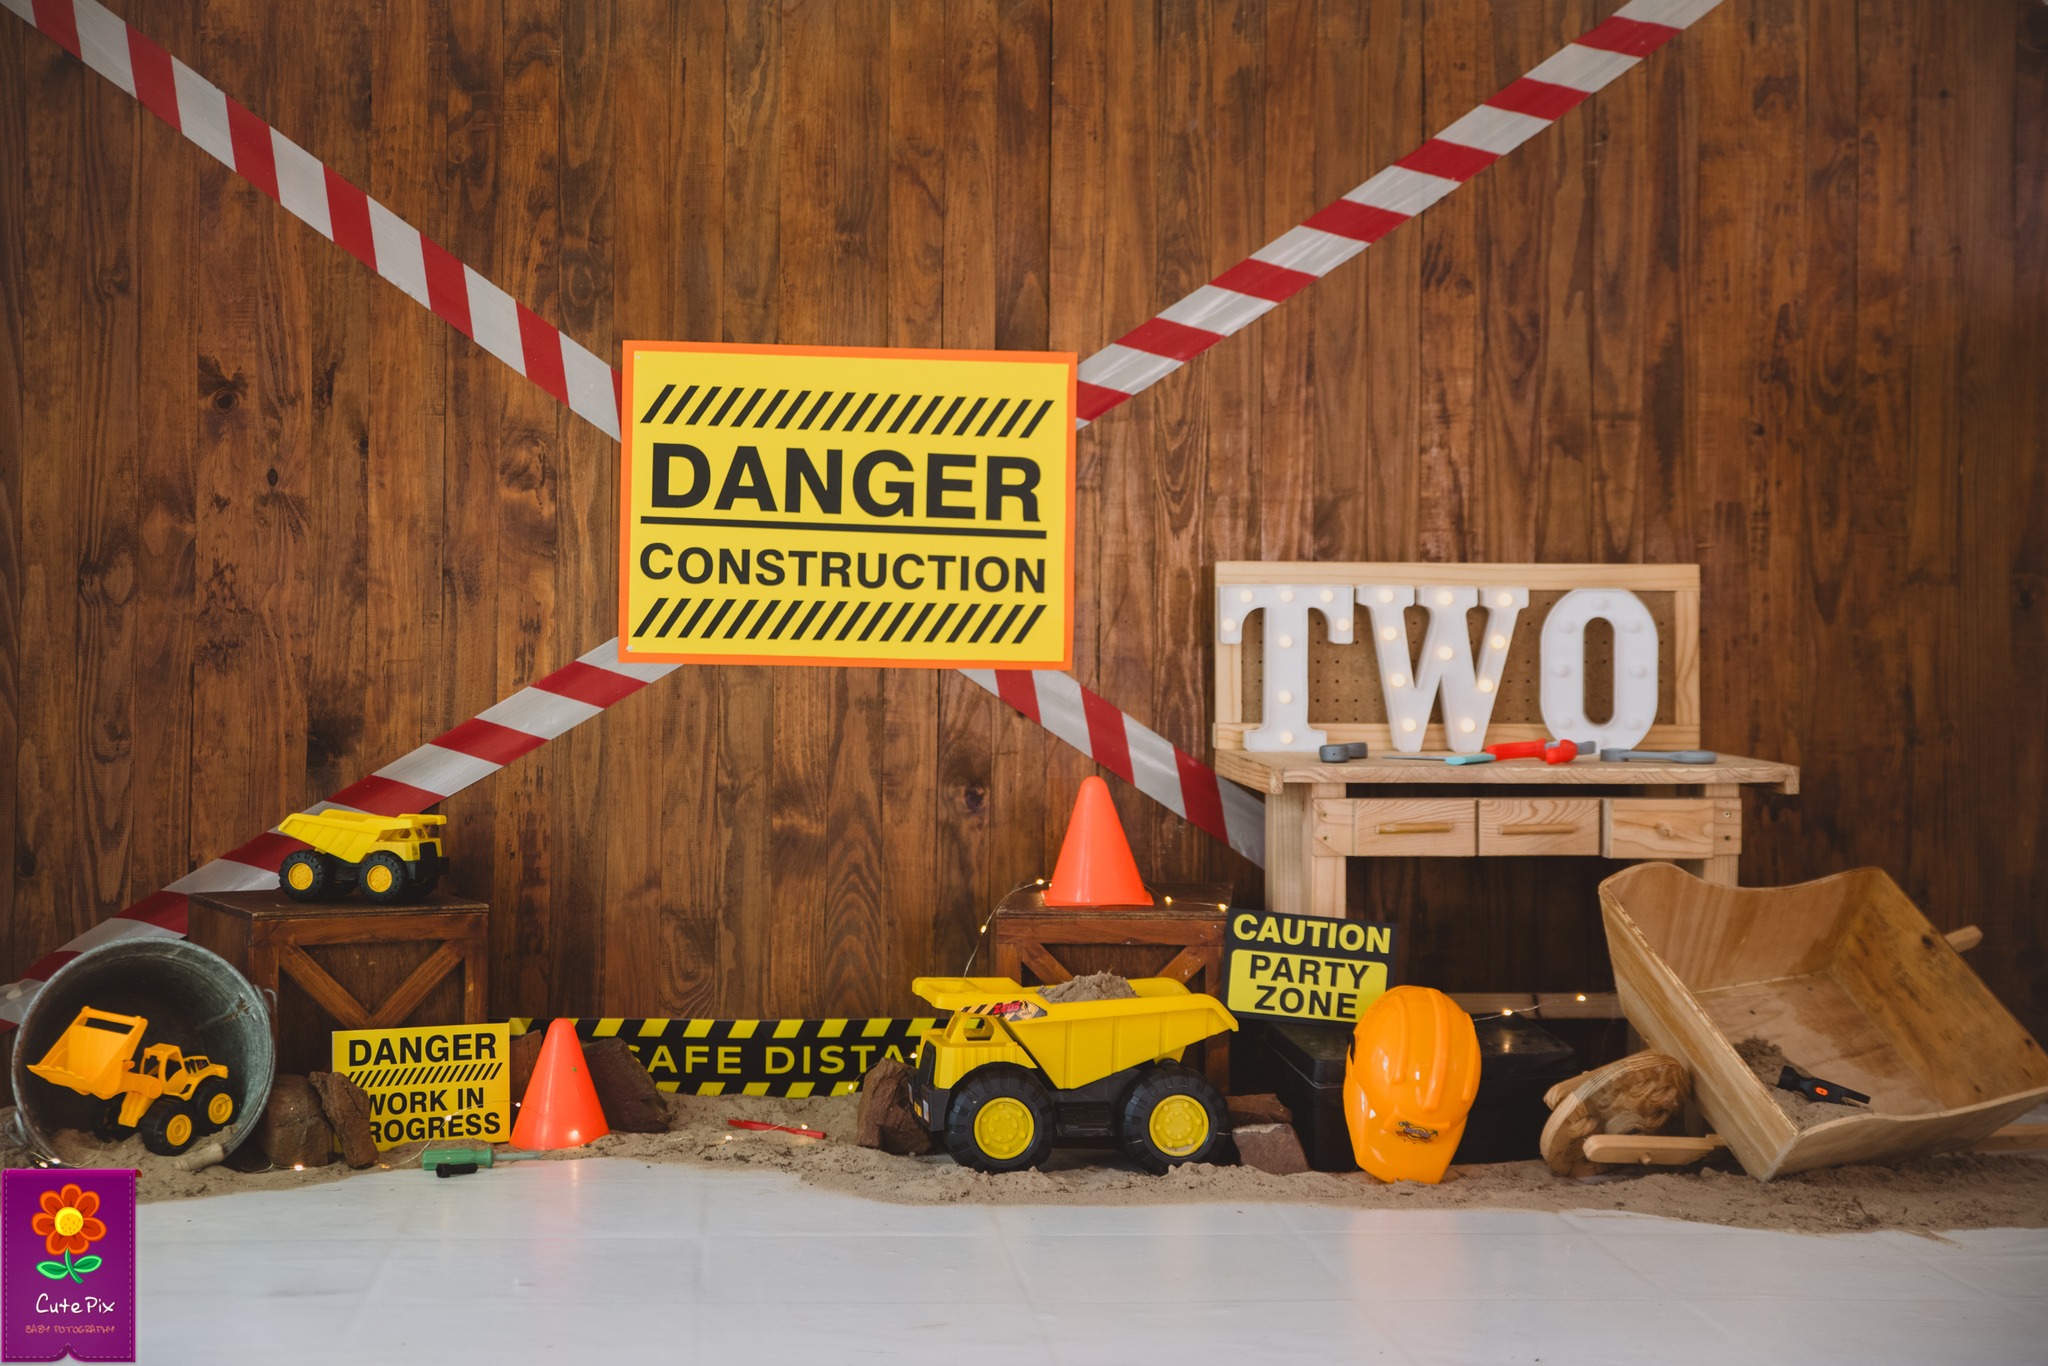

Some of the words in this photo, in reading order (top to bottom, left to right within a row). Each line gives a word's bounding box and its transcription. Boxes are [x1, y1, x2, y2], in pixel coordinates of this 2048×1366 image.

[651, 442, 1042, 522] DANGER
[639, 542, 1046, 594] CONSTRUCTION
[1218, 583, 1659, 754] TWO
[1233, 913, 1391, 954] CAUTION
[1249, 954, 1370, 990] PARTY
[1254, 984, 1358, 1020] ZONE
[348, 1032, 497, 1067] DANGER
[764, 1044, 920, 1075] DISTA
[457, 1087, 484, 1110] IN
[369, 1112, 501, 1143] ROGRESS
